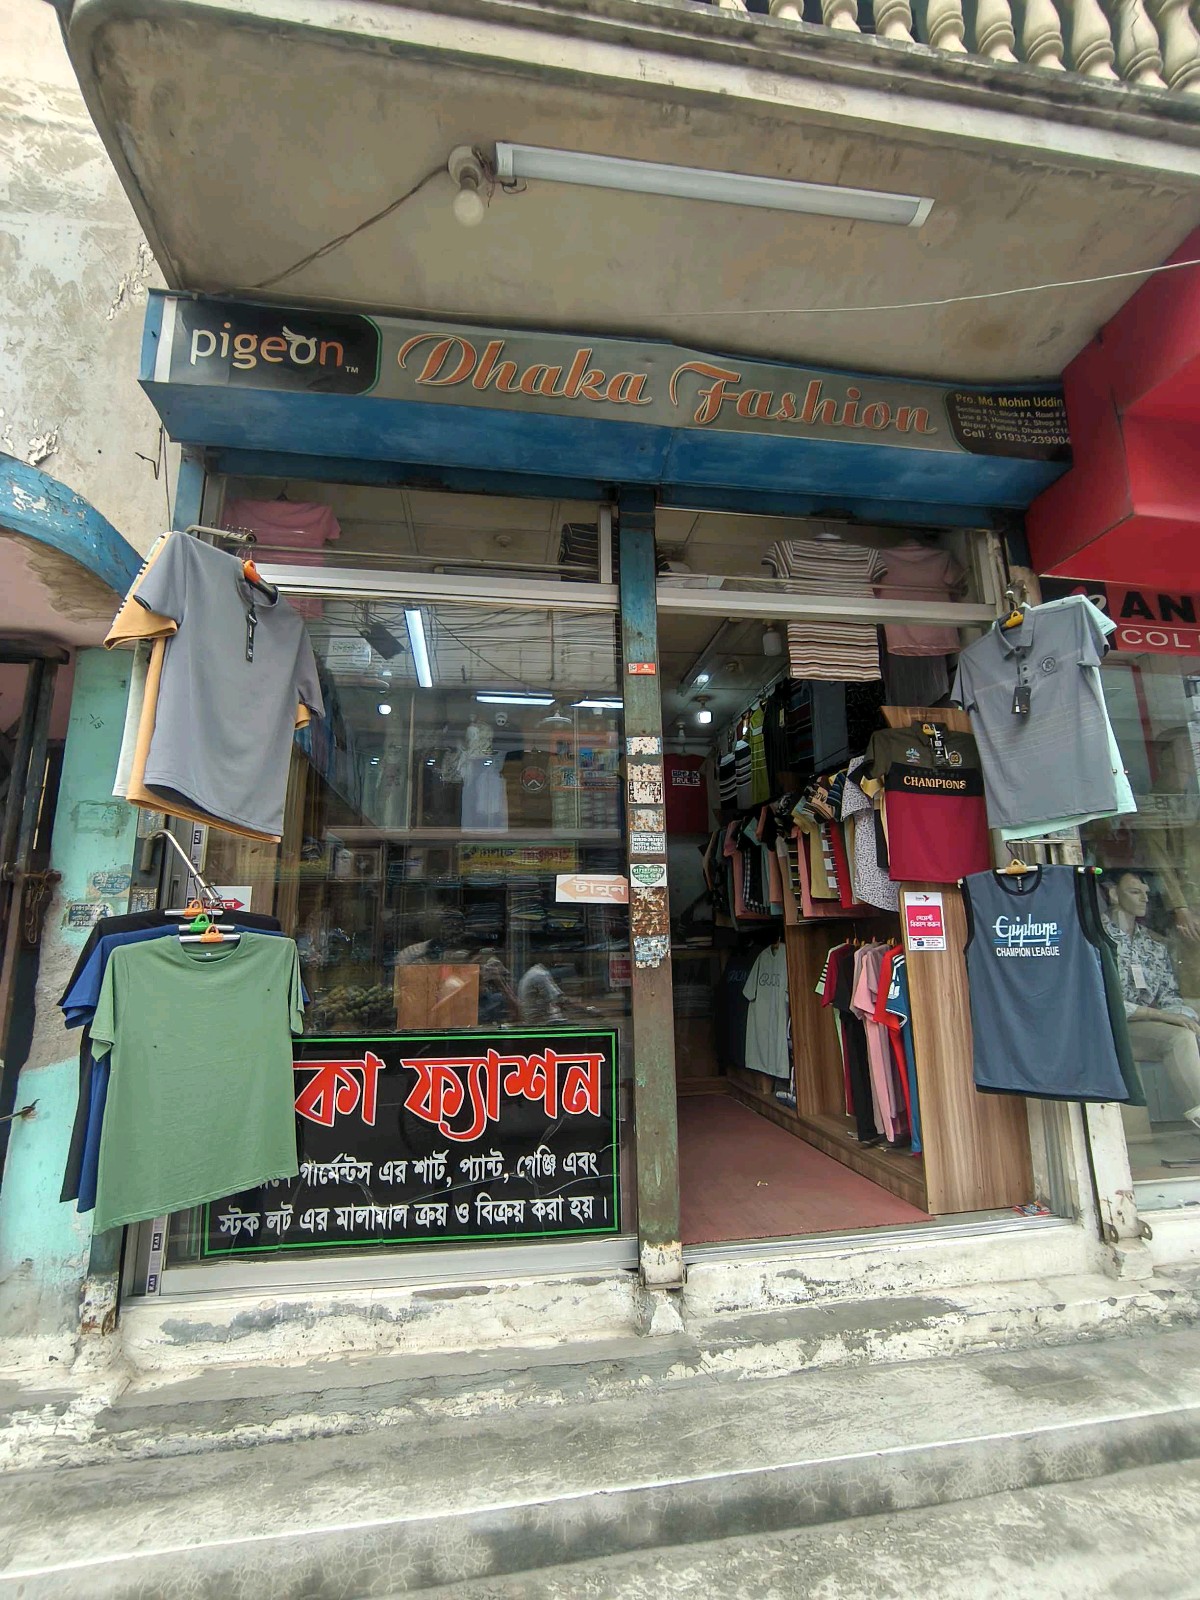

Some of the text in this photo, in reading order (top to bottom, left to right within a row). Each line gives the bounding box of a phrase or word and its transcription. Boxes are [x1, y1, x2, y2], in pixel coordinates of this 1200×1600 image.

[190, 322, 344, 370] pigeon
[397, 333, 938, 434] Dhaka Fashion
[999, 396, 1031, 408] Mohin
[1034, 397, 1063, 408] Uddin
[963, 428, 985, 438] Cell
[1120, 590, 1200, 624] AN
[1121, 629, 1200, 649] COL
[903, 775, 967, 790] CHAMPIONS
[572, 878, 627, 897] টানুন
[992, 913, 1057, 947] Epiphone
[996, 946, 1061, 958] CHAMPION LEAGUE
[400, 1048, 606, 1142] ফ্যাশন
[300, 1152, 374, 1187] গার্মেন্টস
[378, 1159, 409, 1186] এর
[412, 1149, 452, 1188] শার্ট,
[459, 1147, 509, 1184] প্যান্ট,
[516, 1144, 557, 1179] গেঞ্জি
[562, 1152, 600, 1177] এবং
[217, 1204, 261, 1238] স্টক
[264, 1201, 294, 1236] লট
[300, 1207, 330, 1234] এর
[333, 1202, 410, 1233] মালামাল
[413, 1202, 449, 1229] ক্রয়
[454, 1202, 470, 1224] ও
[474, 1191, 526, 1226] বিক্রয়
[529, 1194, 565, 1223] করা
